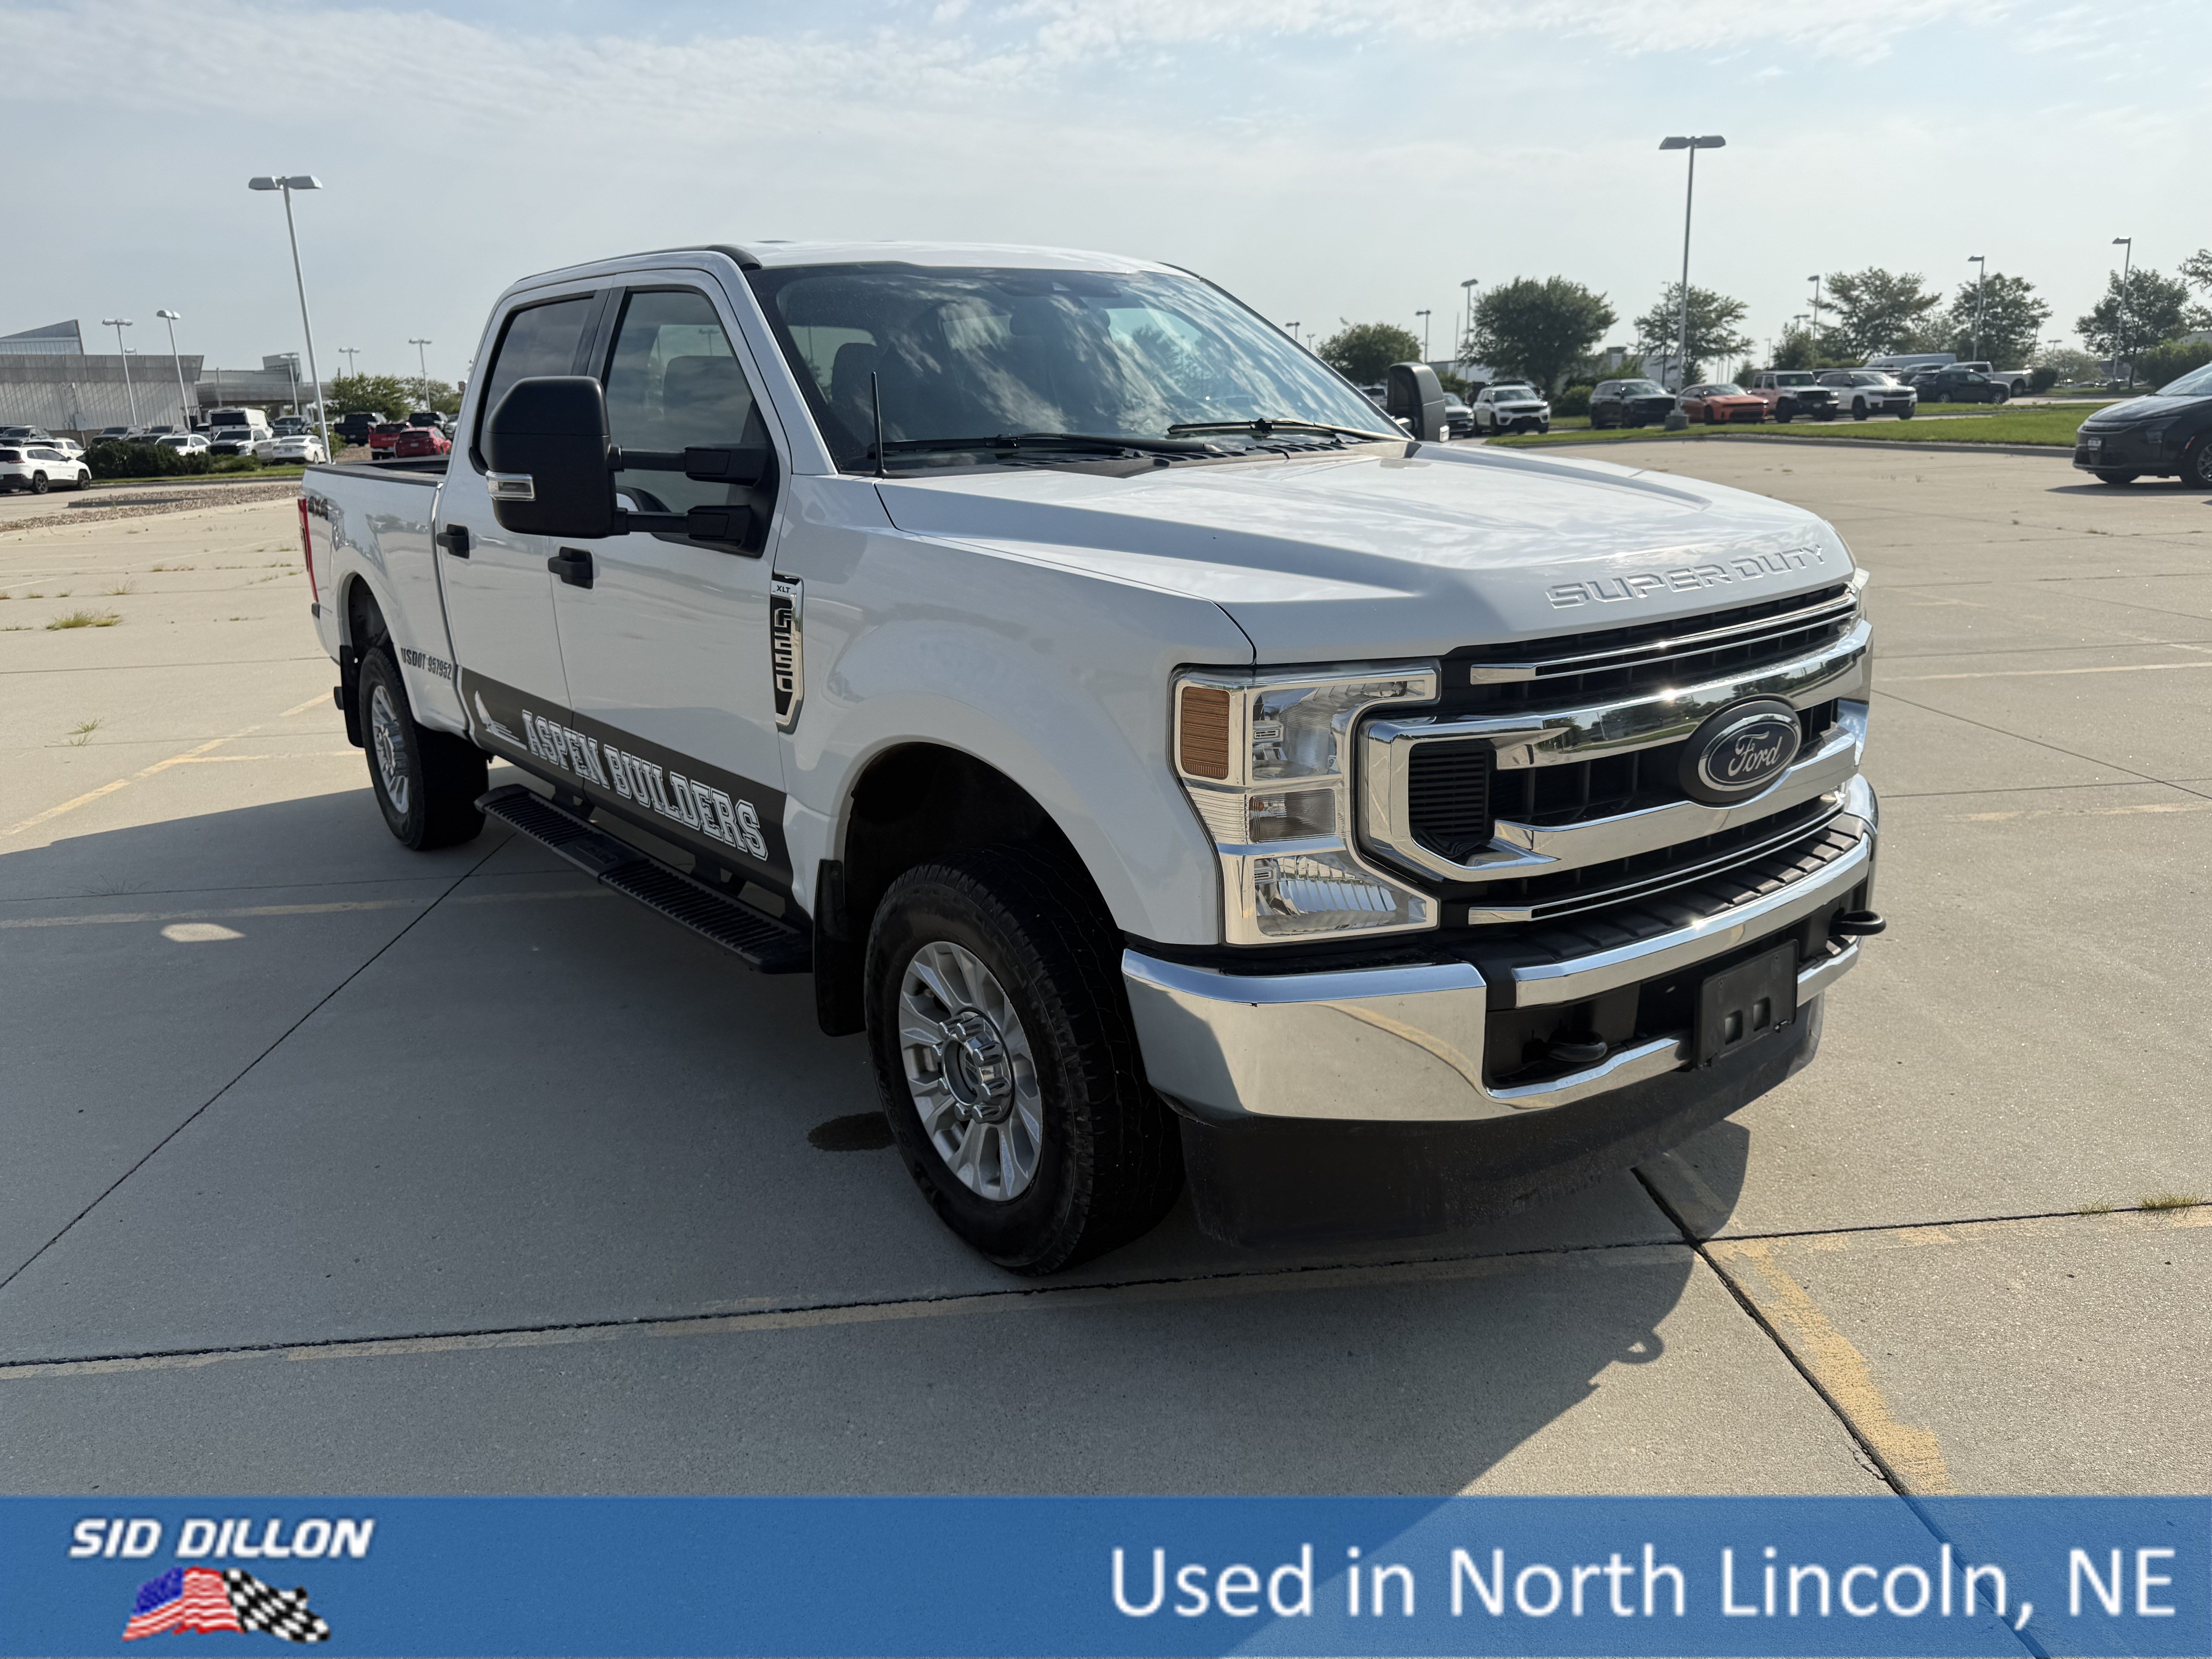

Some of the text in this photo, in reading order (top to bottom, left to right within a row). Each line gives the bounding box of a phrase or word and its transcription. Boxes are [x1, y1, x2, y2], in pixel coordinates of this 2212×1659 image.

[777, 585, 790, 593] XLT
[1545, 544, 1824, 609] SUPER DUTY
[401, 647, 452, 680] USDOT 957952
[1728, 731, 1783, 777] Ford
[522, 709, 769, 861] ASPEN BUILDERS
